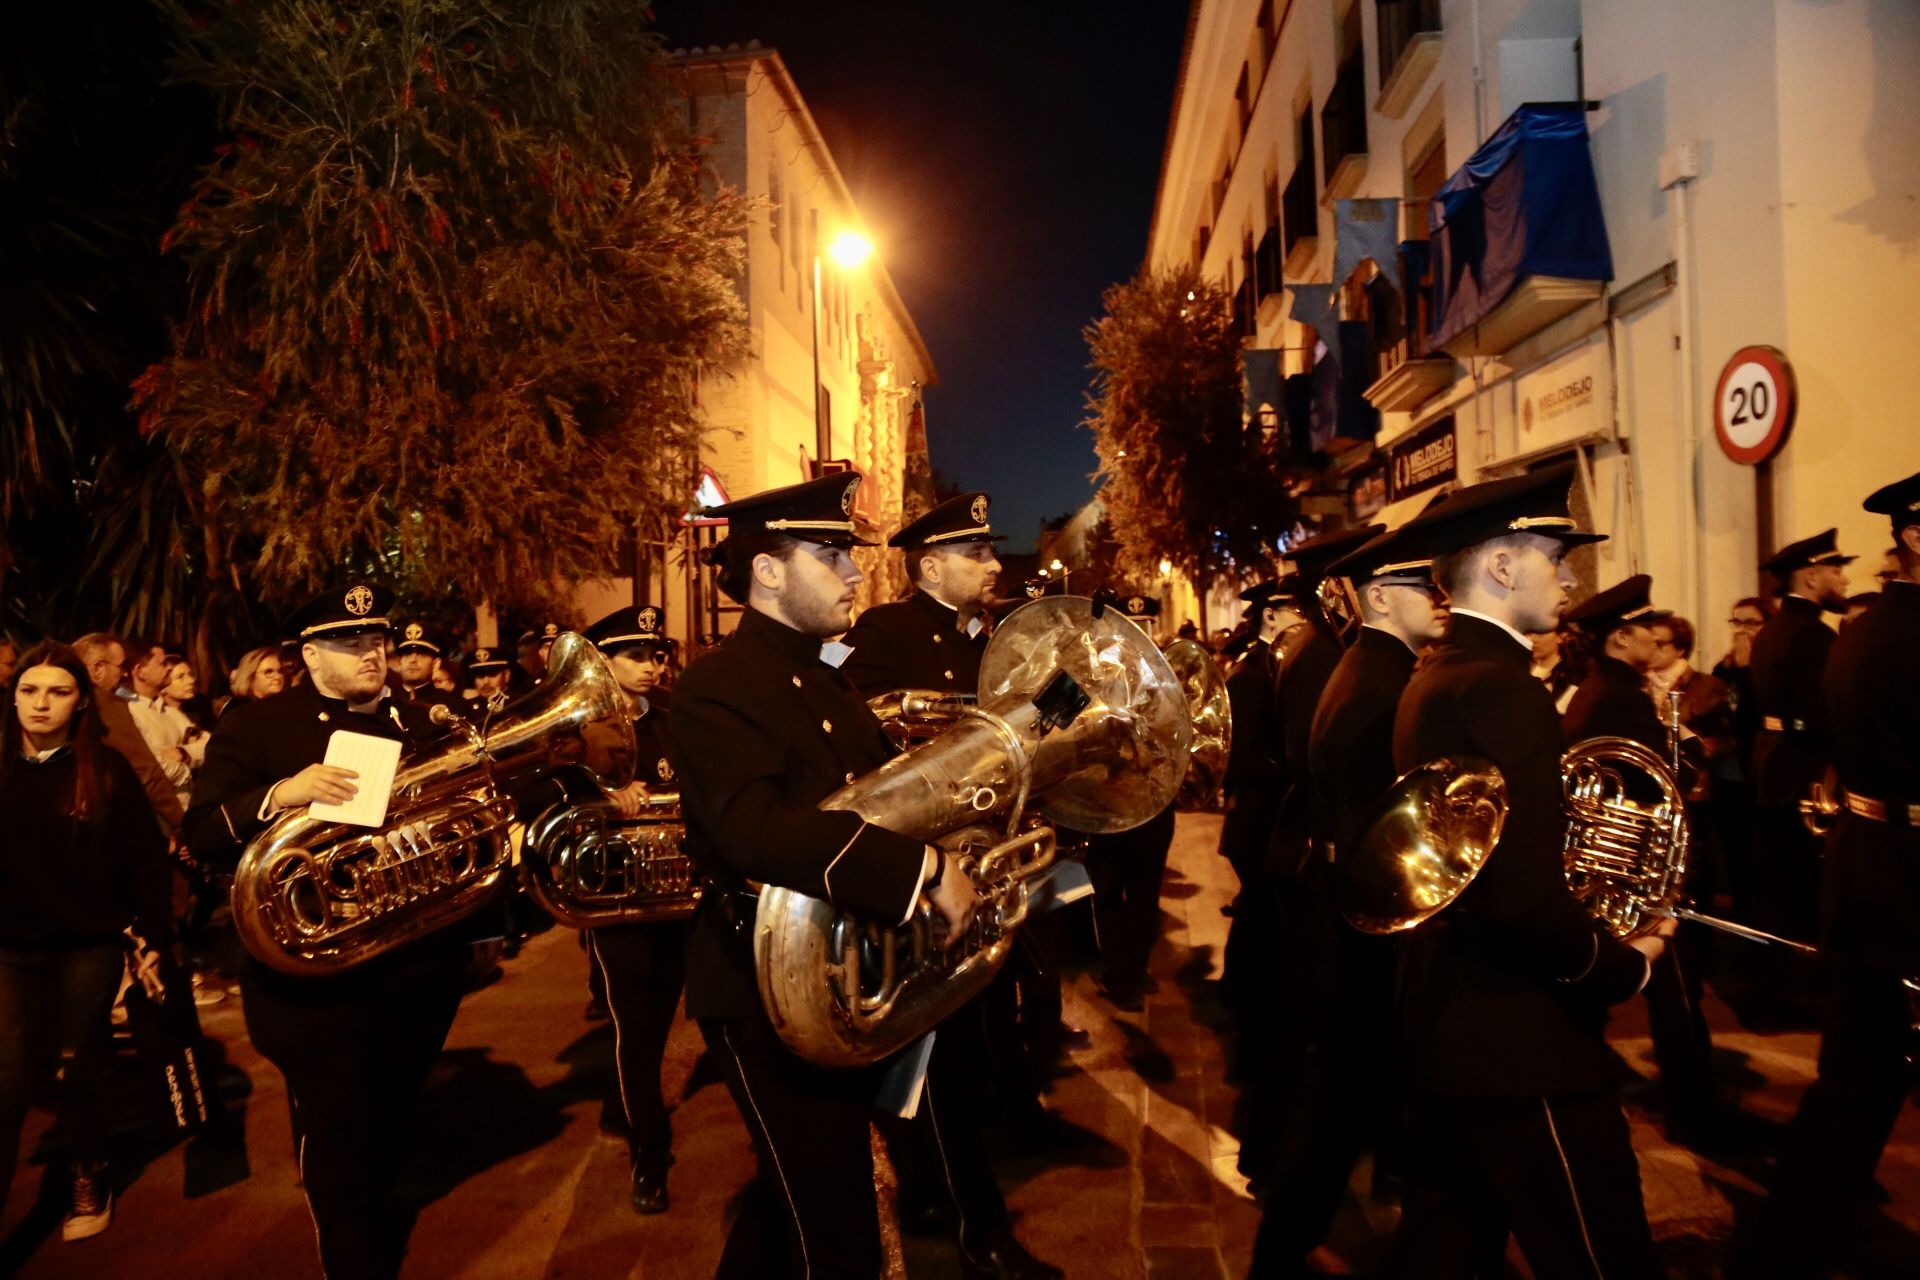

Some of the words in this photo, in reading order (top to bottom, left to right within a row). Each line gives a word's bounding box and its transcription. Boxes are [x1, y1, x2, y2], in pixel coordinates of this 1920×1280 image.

[1539, 376, 1593, 409] MELODEJO
[1731, 381, 1768, 426] 20
[1410, 434, 1454, 469] MELODEJO
